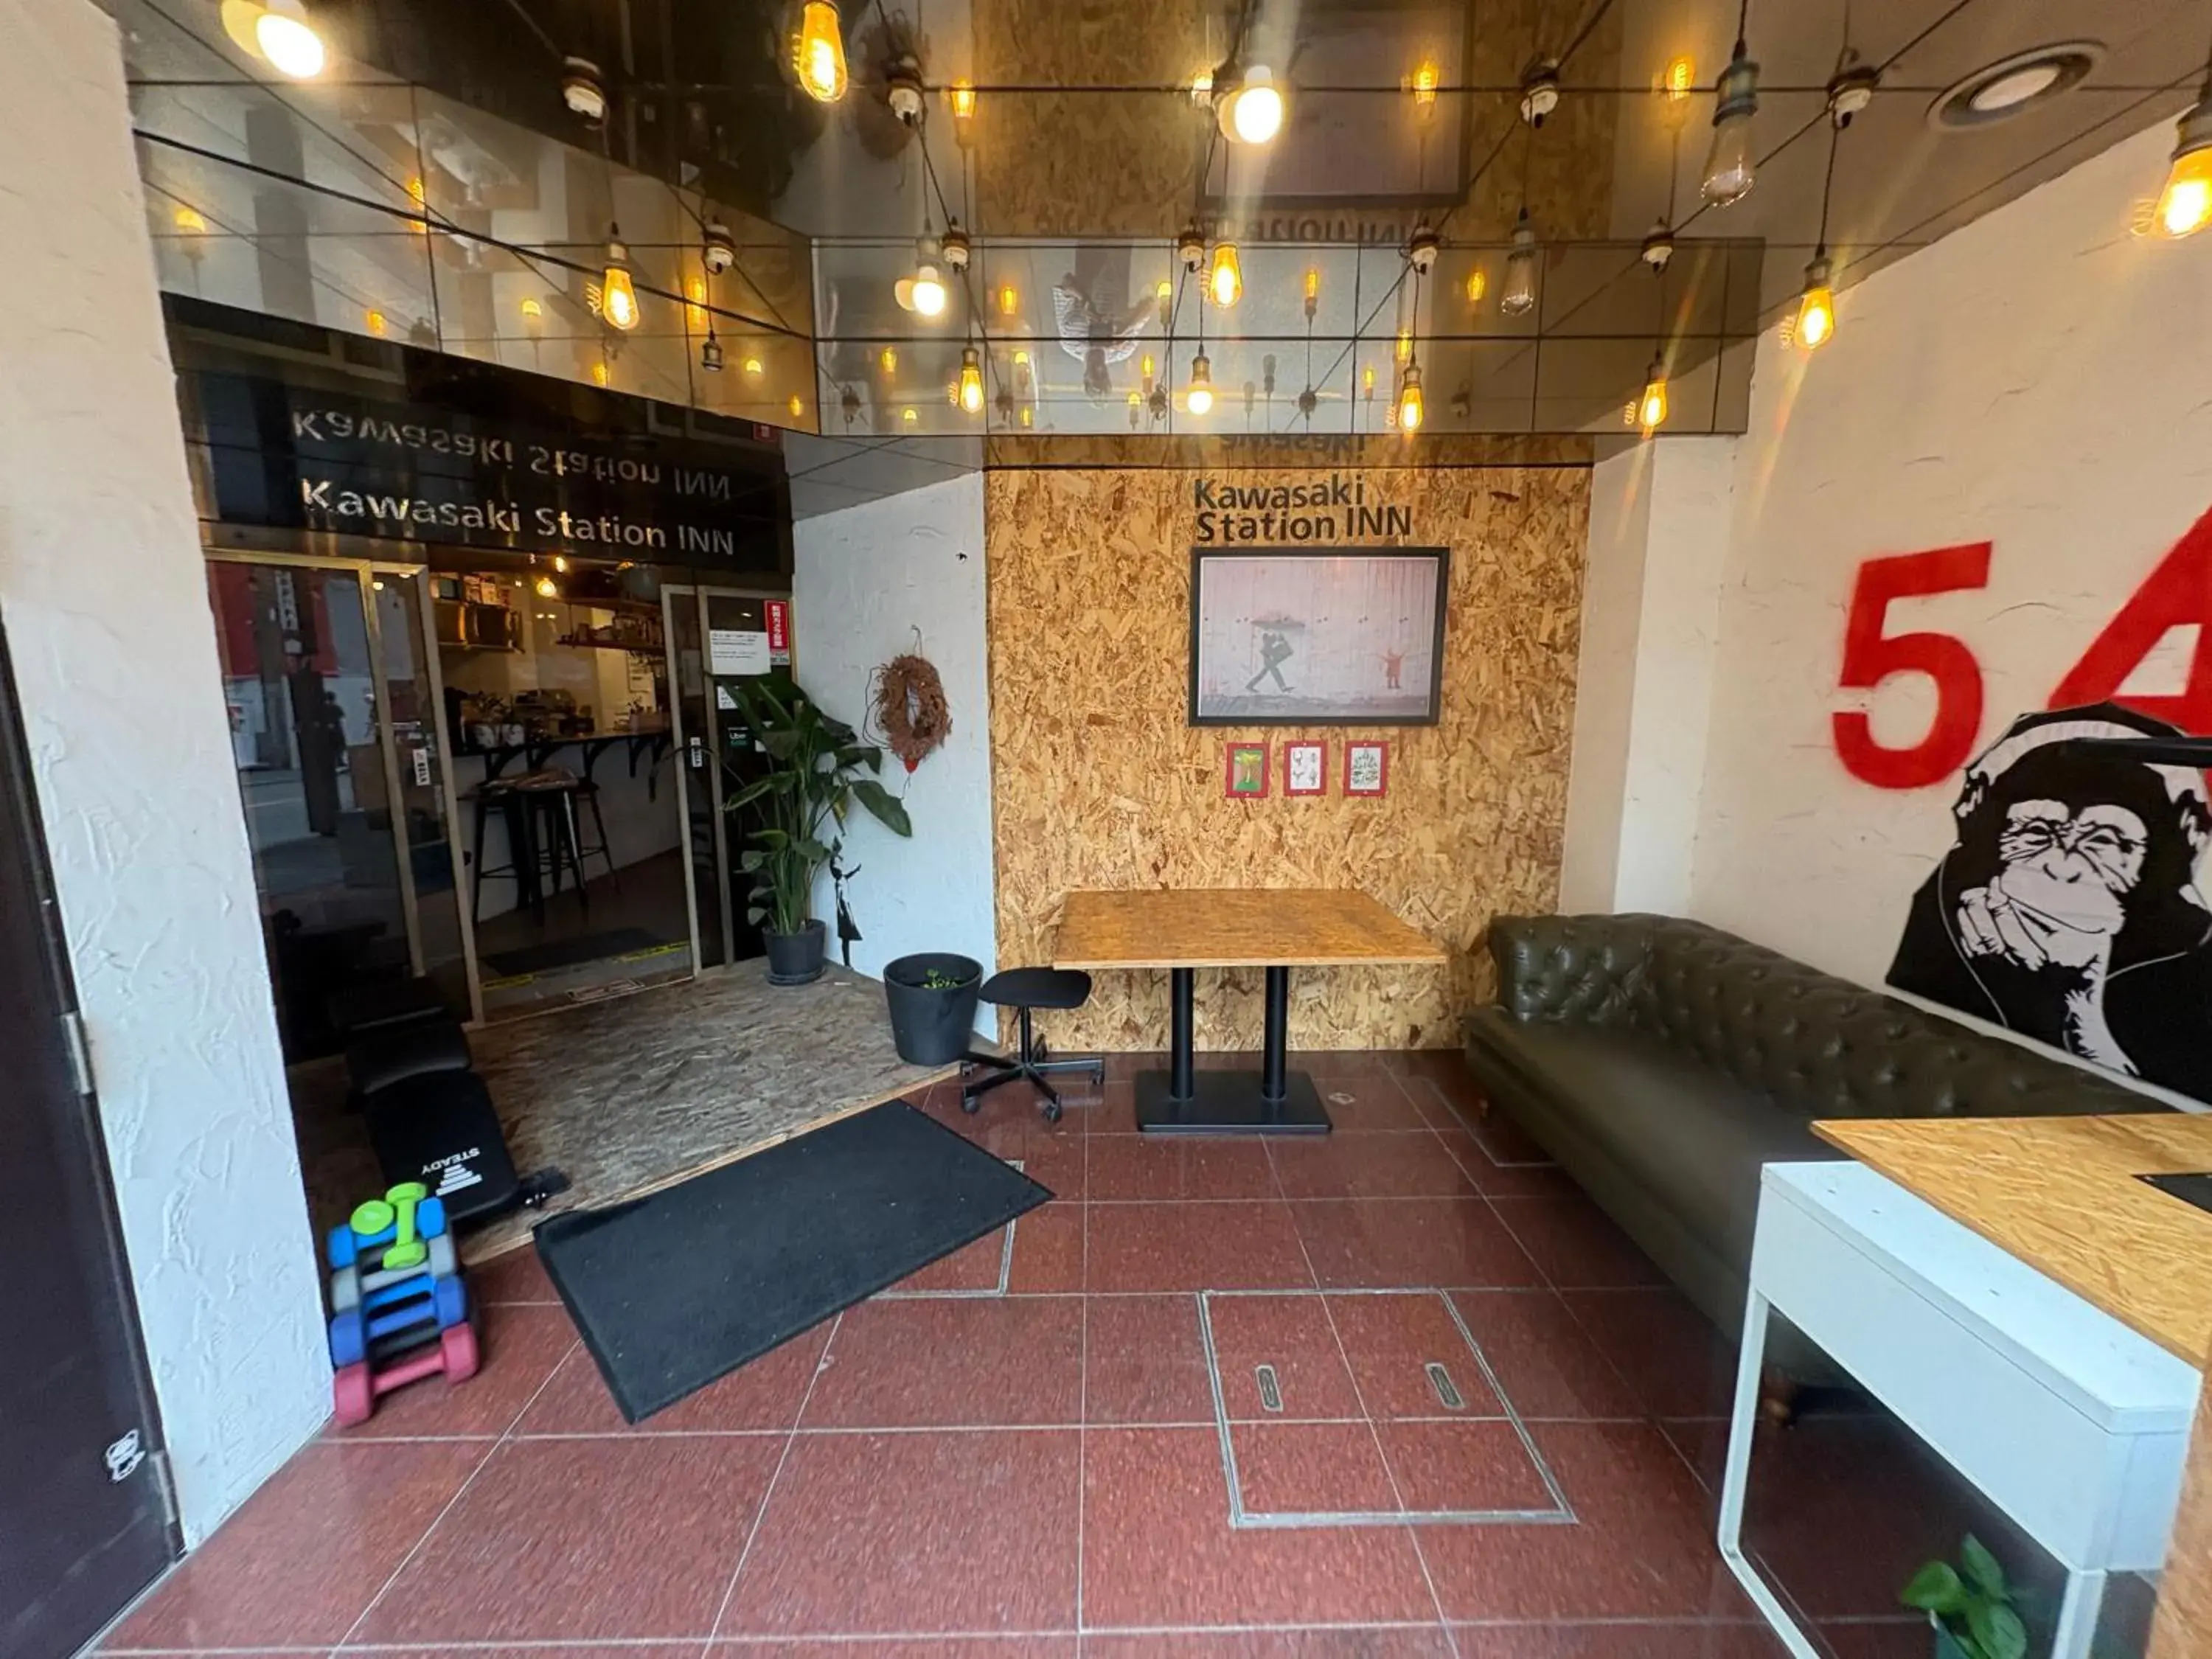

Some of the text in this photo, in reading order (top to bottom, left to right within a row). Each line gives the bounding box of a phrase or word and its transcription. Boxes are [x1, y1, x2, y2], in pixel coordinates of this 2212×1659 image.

[1194, 473, 1363, 509] Kawasaki
[301, 478, 734, 555] Kawasaki Station INN
[1196, 506, 1412, 542] Station INN
[421, 1147, 481, 1176] STEADY
